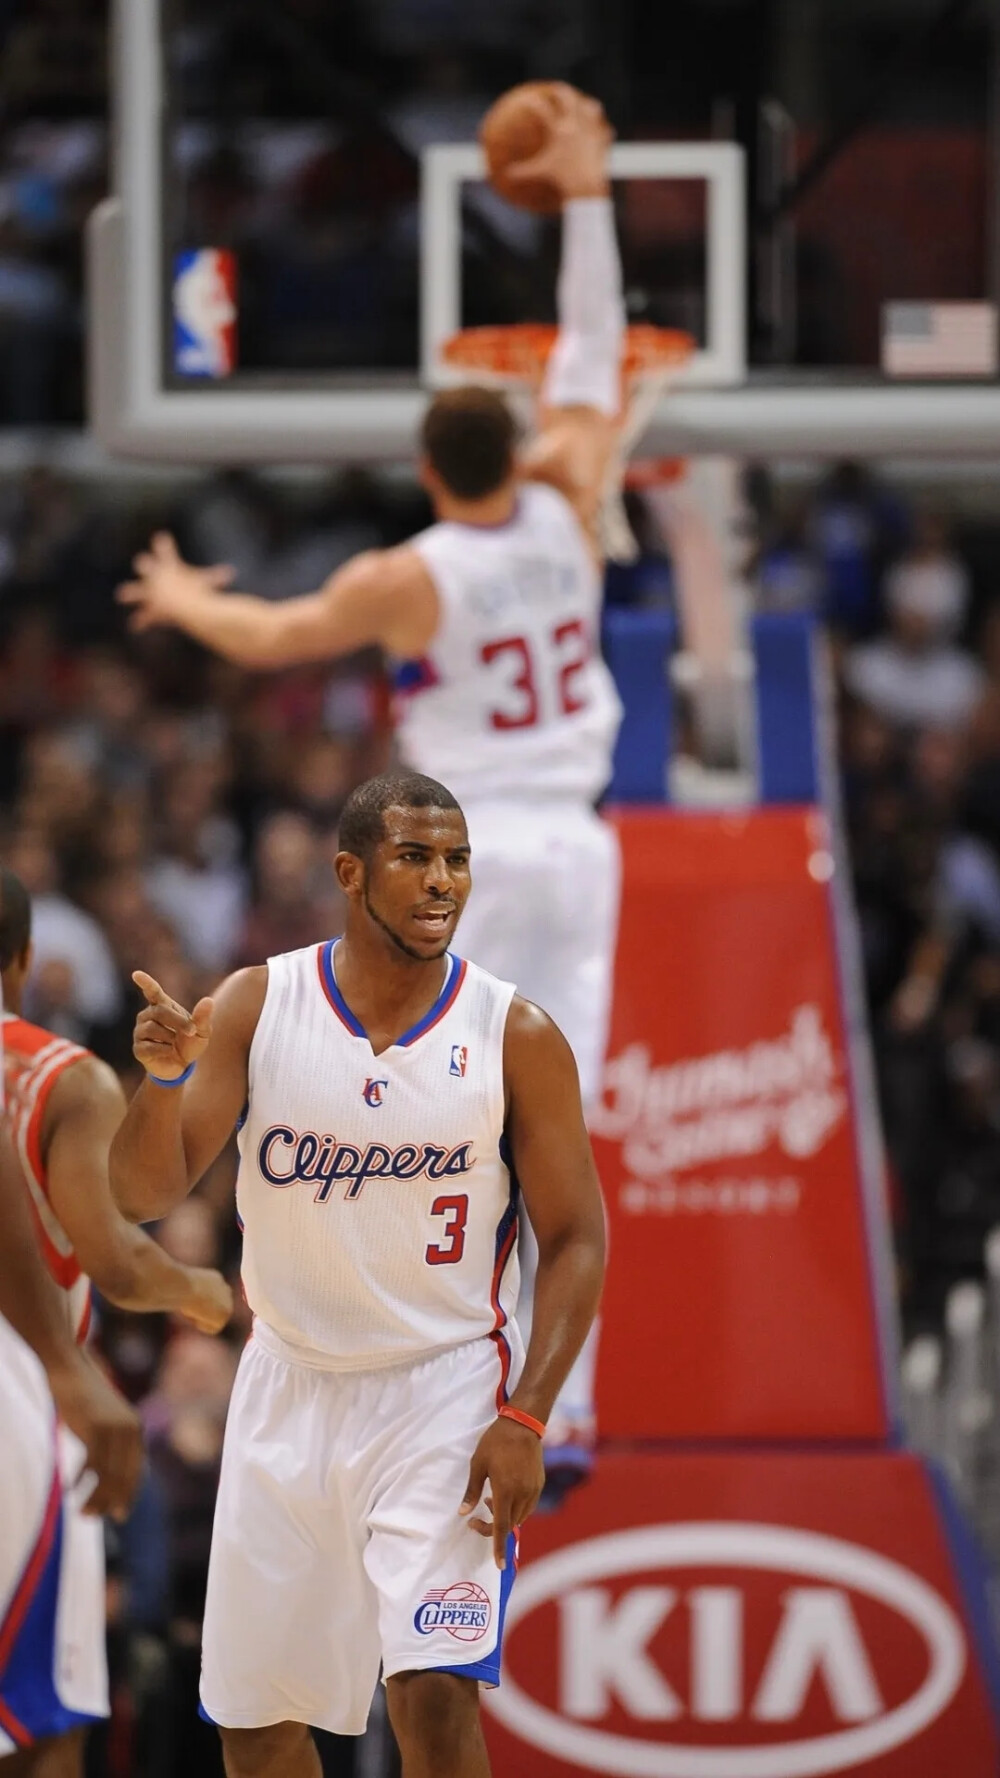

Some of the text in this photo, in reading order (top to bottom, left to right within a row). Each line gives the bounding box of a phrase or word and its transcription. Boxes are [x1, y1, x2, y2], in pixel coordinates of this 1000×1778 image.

[479, 619, 590, 732] 32
[258, 1125, 476, 1203] Clippers
[426, 1194, 468, 1265] 3
[413, 1602, 487, 1635] CLIPPERS
[558, 1584, 886, 1722] KIA
